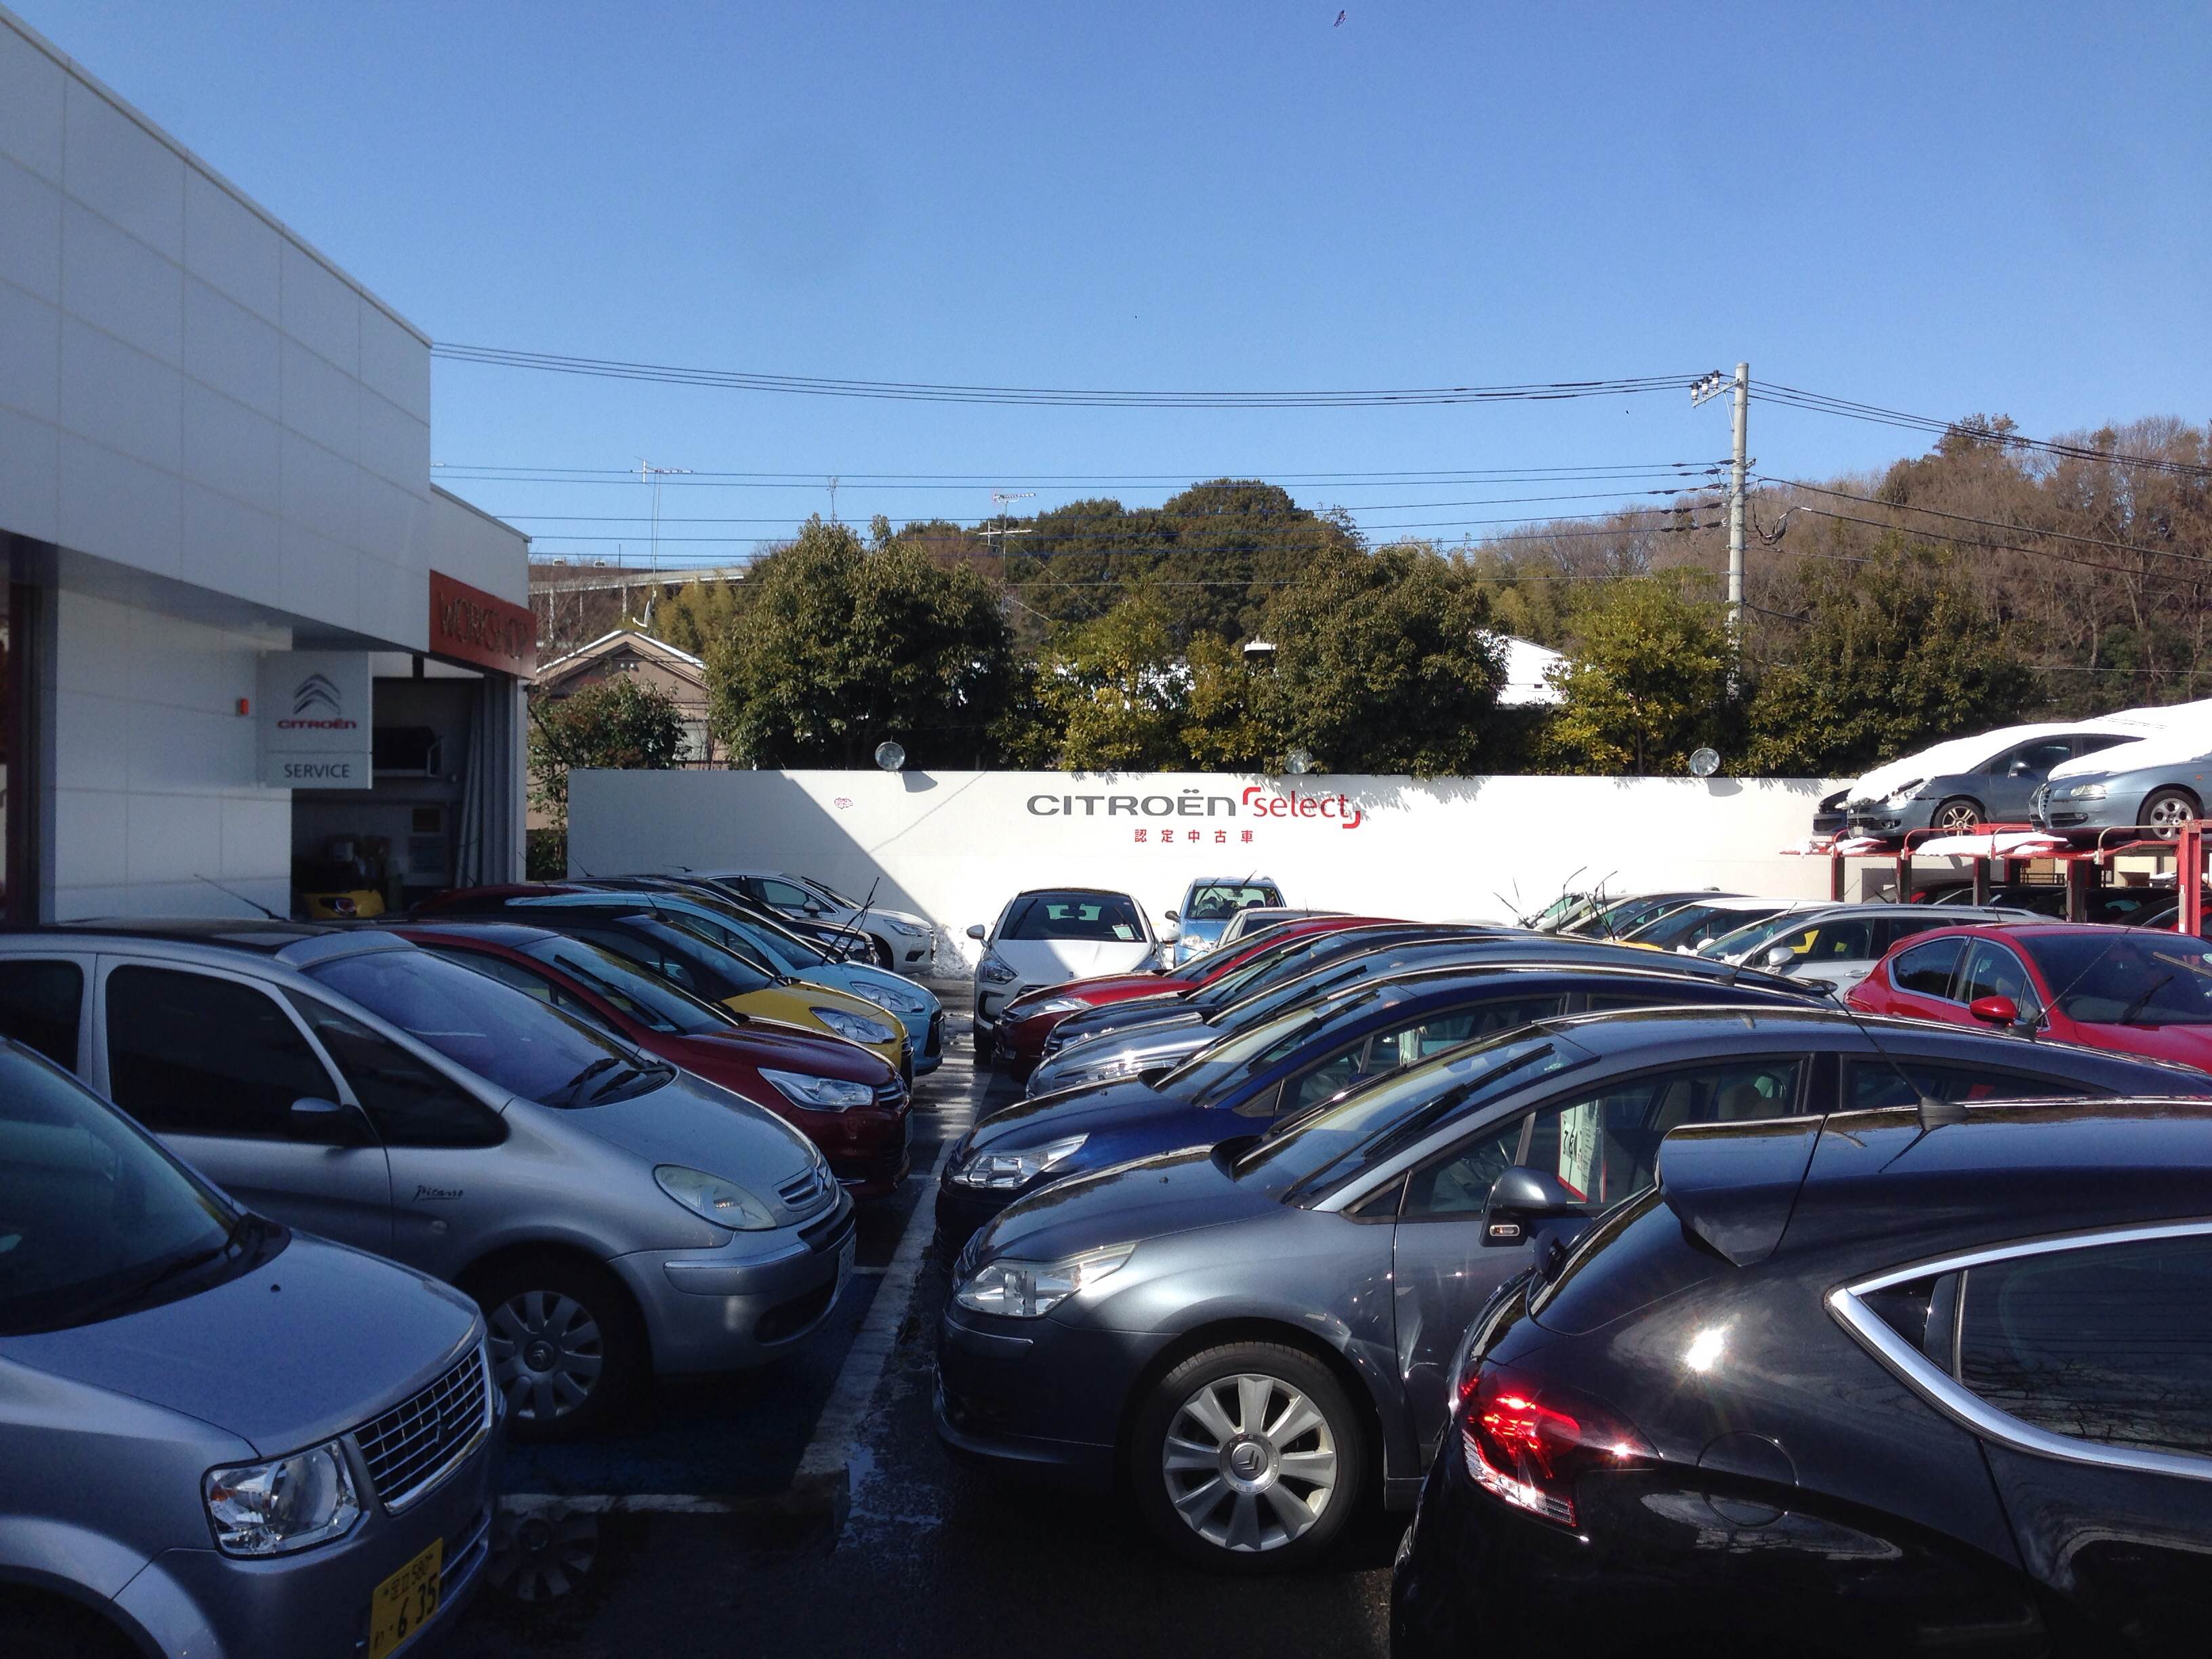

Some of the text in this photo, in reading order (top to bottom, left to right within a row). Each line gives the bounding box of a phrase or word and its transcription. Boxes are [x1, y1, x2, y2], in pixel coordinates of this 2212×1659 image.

[284, 764, 350, 779] SERVICE
[1134, 829, 1254, 844] 認定中古車
